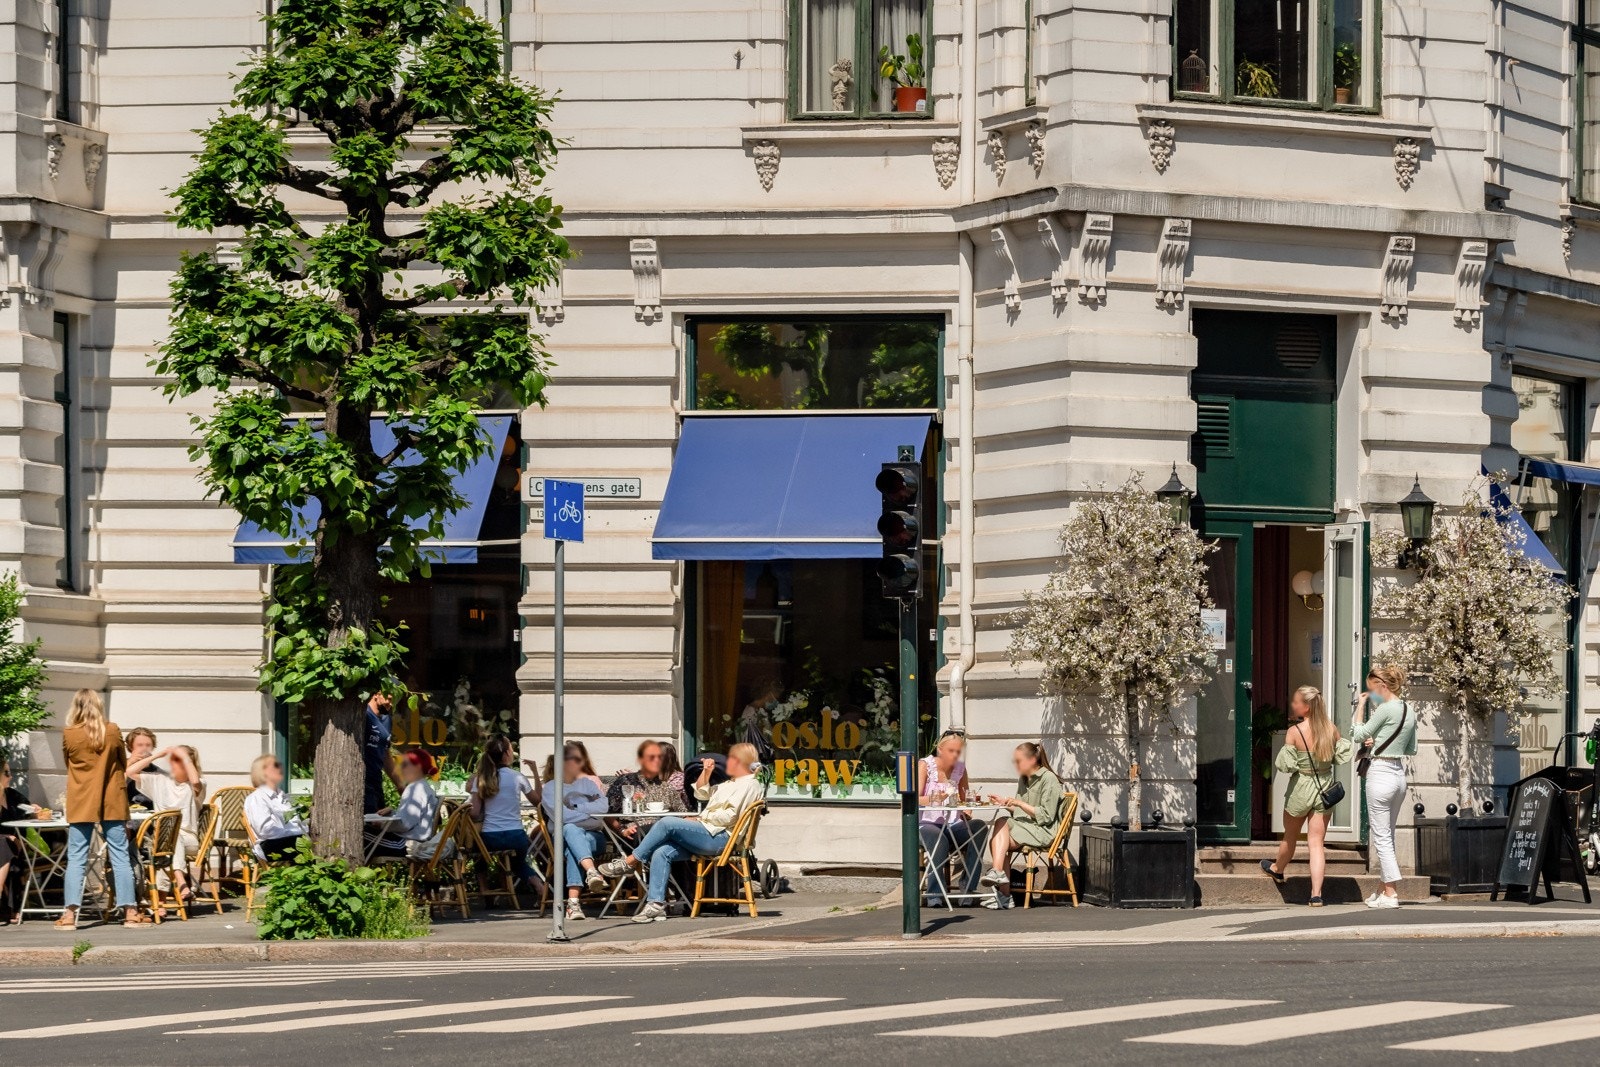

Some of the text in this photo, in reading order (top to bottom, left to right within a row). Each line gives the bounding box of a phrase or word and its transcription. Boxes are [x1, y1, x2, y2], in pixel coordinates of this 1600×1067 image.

[611, 483, 635, 495] gate
[391, 708, 448, 746] slo
[772, 706, 861, 750] oslo
[774, 758, 862, 786] raw
